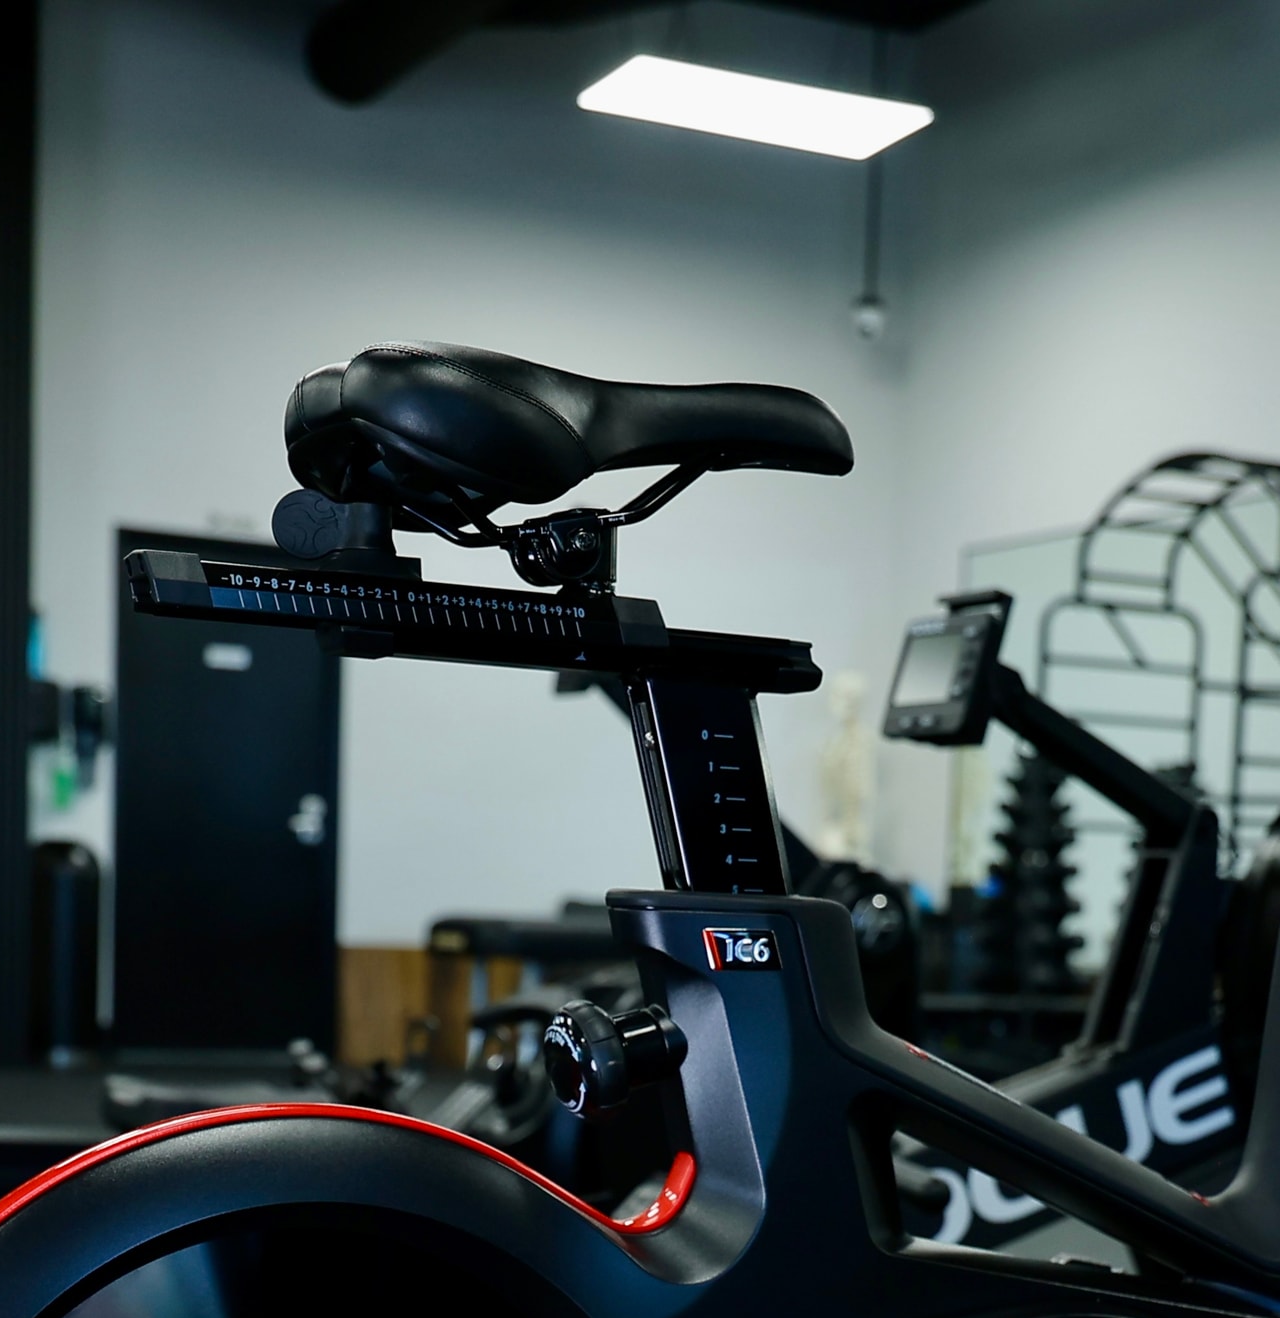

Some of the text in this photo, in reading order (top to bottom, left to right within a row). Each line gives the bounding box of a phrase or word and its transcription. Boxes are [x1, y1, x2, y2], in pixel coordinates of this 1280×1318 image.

[700, 728, 709, 741] 0
[708, 761, 715, 773] 1
[713, 793, 721, 804] 2
[719, 824, 727, 835] 3
[725, 854, 733, 866] 4
[725, 937, 771, 964] IC6
